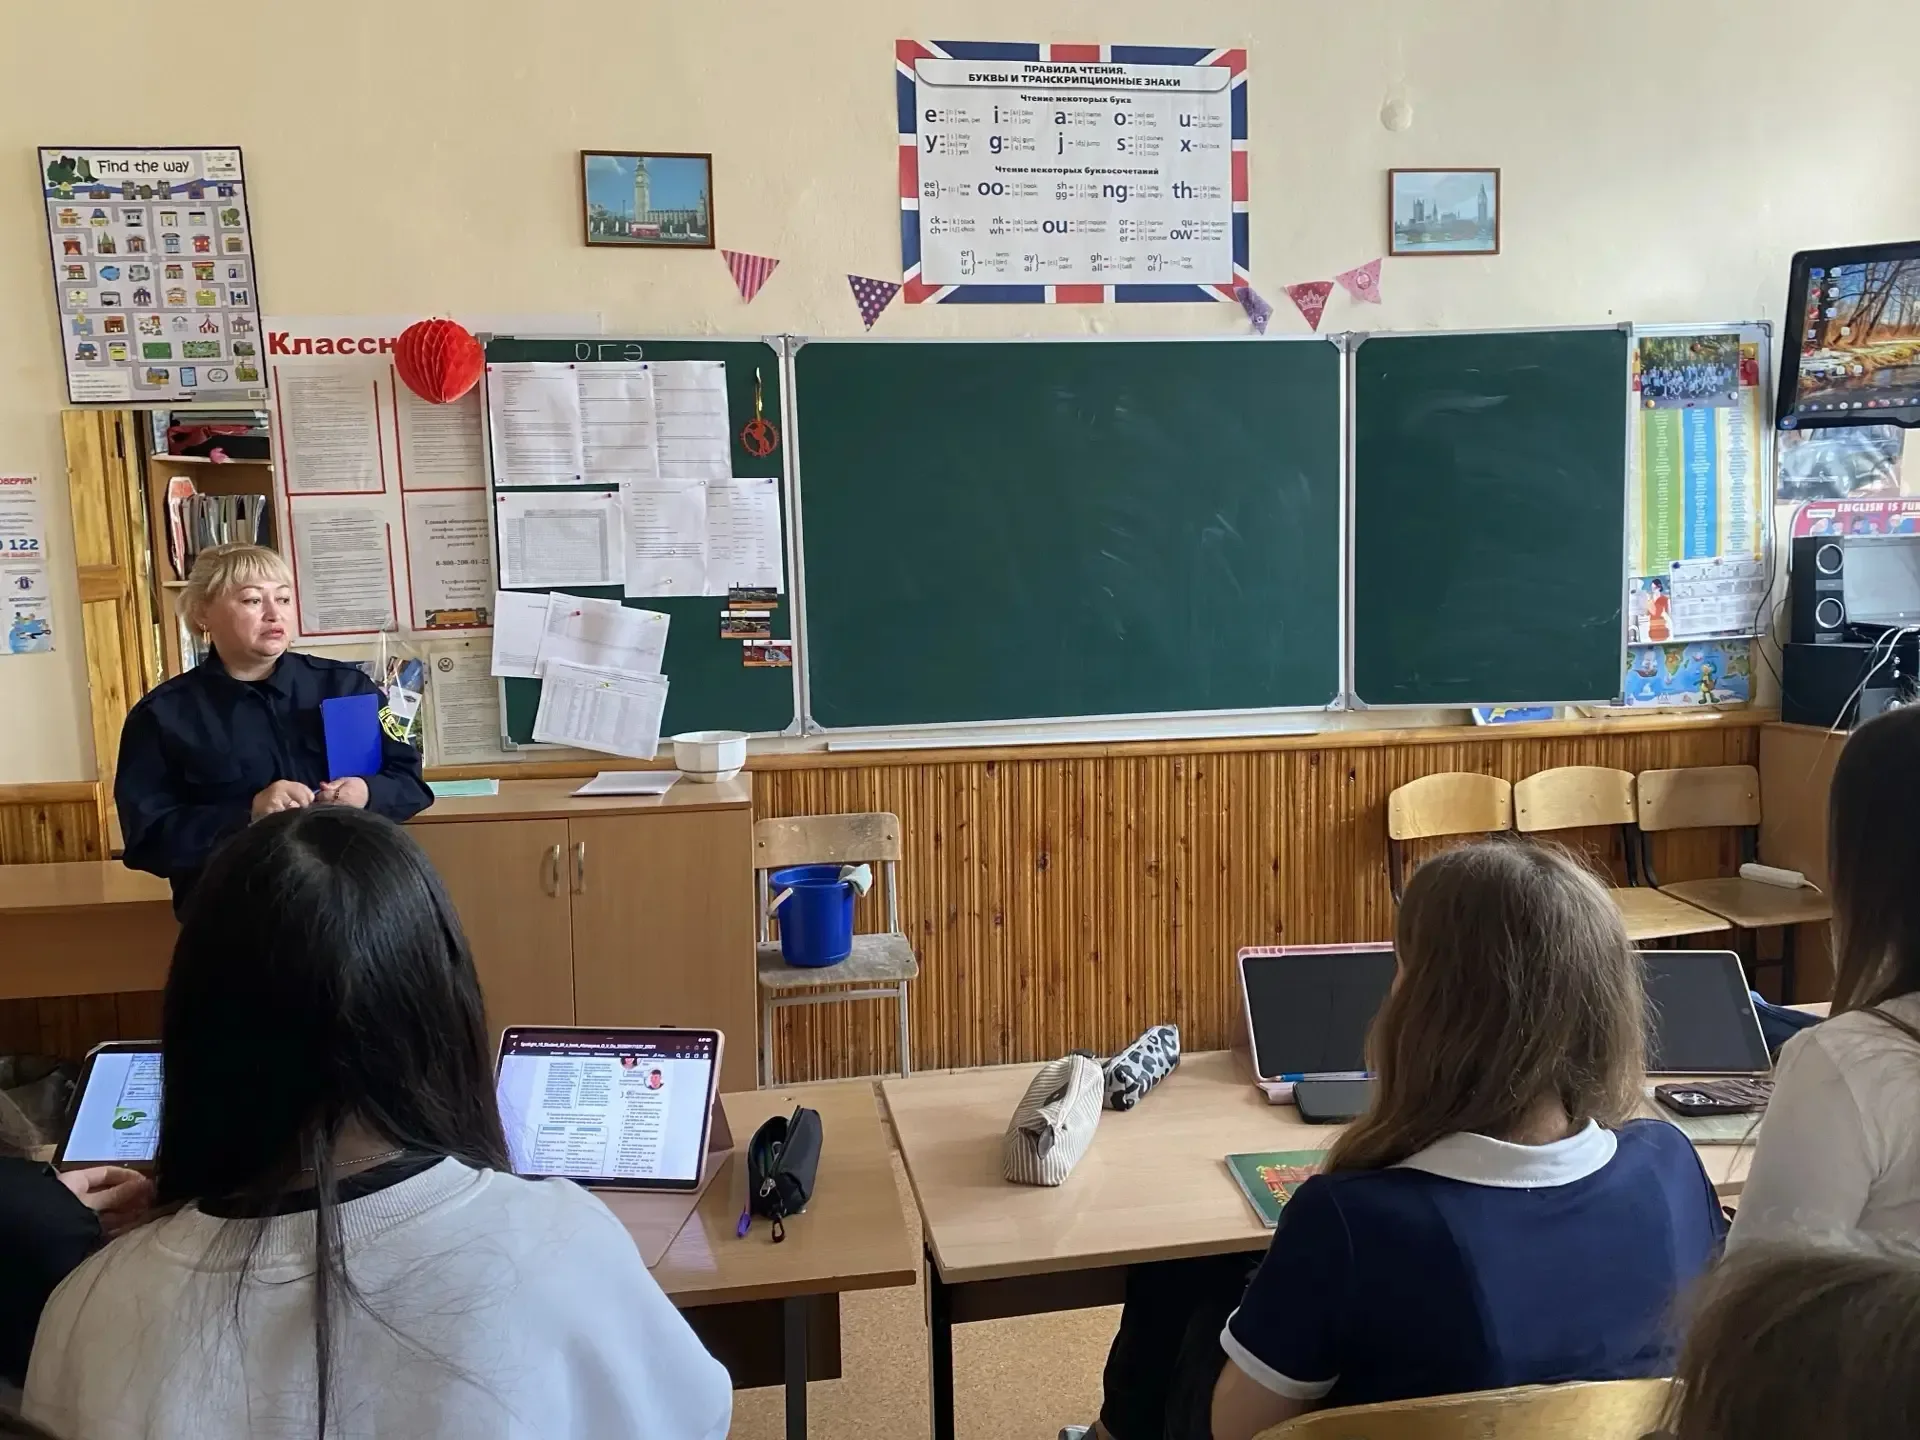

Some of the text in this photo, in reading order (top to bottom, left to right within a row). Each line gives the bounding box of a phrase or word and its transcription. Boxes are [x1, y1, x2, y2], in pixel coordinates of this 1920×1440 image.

[1024, 65, 1127, 75] ПРАВИЛА ЧТЕНИЯ.
[968, 74, 1181, 87] БУКВЫ И ТРАНСКРИПЦИОННЫЕ ЗНАКИ
[1020, 94, 1131, 106] Чтение некоторых букв
[925, 108, 937, 123] e
[994, 105, 999, 124] i
[1054, 111, 1067, 125] a
[1114, 112, 1127, 126] o
[1179, 114, 1191, 127] u
[925, 134, 938, 153] y
[989, 135, 1002, 154] g
[1057, 132, 1064, 155] j
[1117, 137, 1126, 151] s
[1180, 139, 1192, 152] x
[97, 159, 190, 178] Find the way
[995, 165, 1159, 176] Чтение некоторых буквосочетаний
[977, 182, 1004, 196] oo
[1056, 181, 1067, 190] sh
[1172, 181, 1192, 199] th
[1055, 191, 1067, 201] gg
[1103, 184, 1128, 203] ng
[930, 216, 940, 224] ck
[992, 216, 1004, 225] nk
[1181, 219, 1193, 228] qu
[930, 225, 941, 234] ch
[990, 226, 1004, 235] wh
[1042, 220, 1068, 234] ou
[1170, 230, 1193, 240] ow
[1024, 253, 1035, 263] ay
[1090, 253, 1103, 263] gh
[1147, 254, 1158, 264] oy
[1024, 264, 1032, 272] ai
[1091, 263, 1103, 272] all
[1147, 263, 1156, 272] oi
[268, 332, 397, 355] Классн
[575, 342, 643, 361] ОГЭ
[1837, 502, 1884, 513] ENGLISH
[1887, 502, 1899, 511] IS
[9, 538, 39, 551] 122
